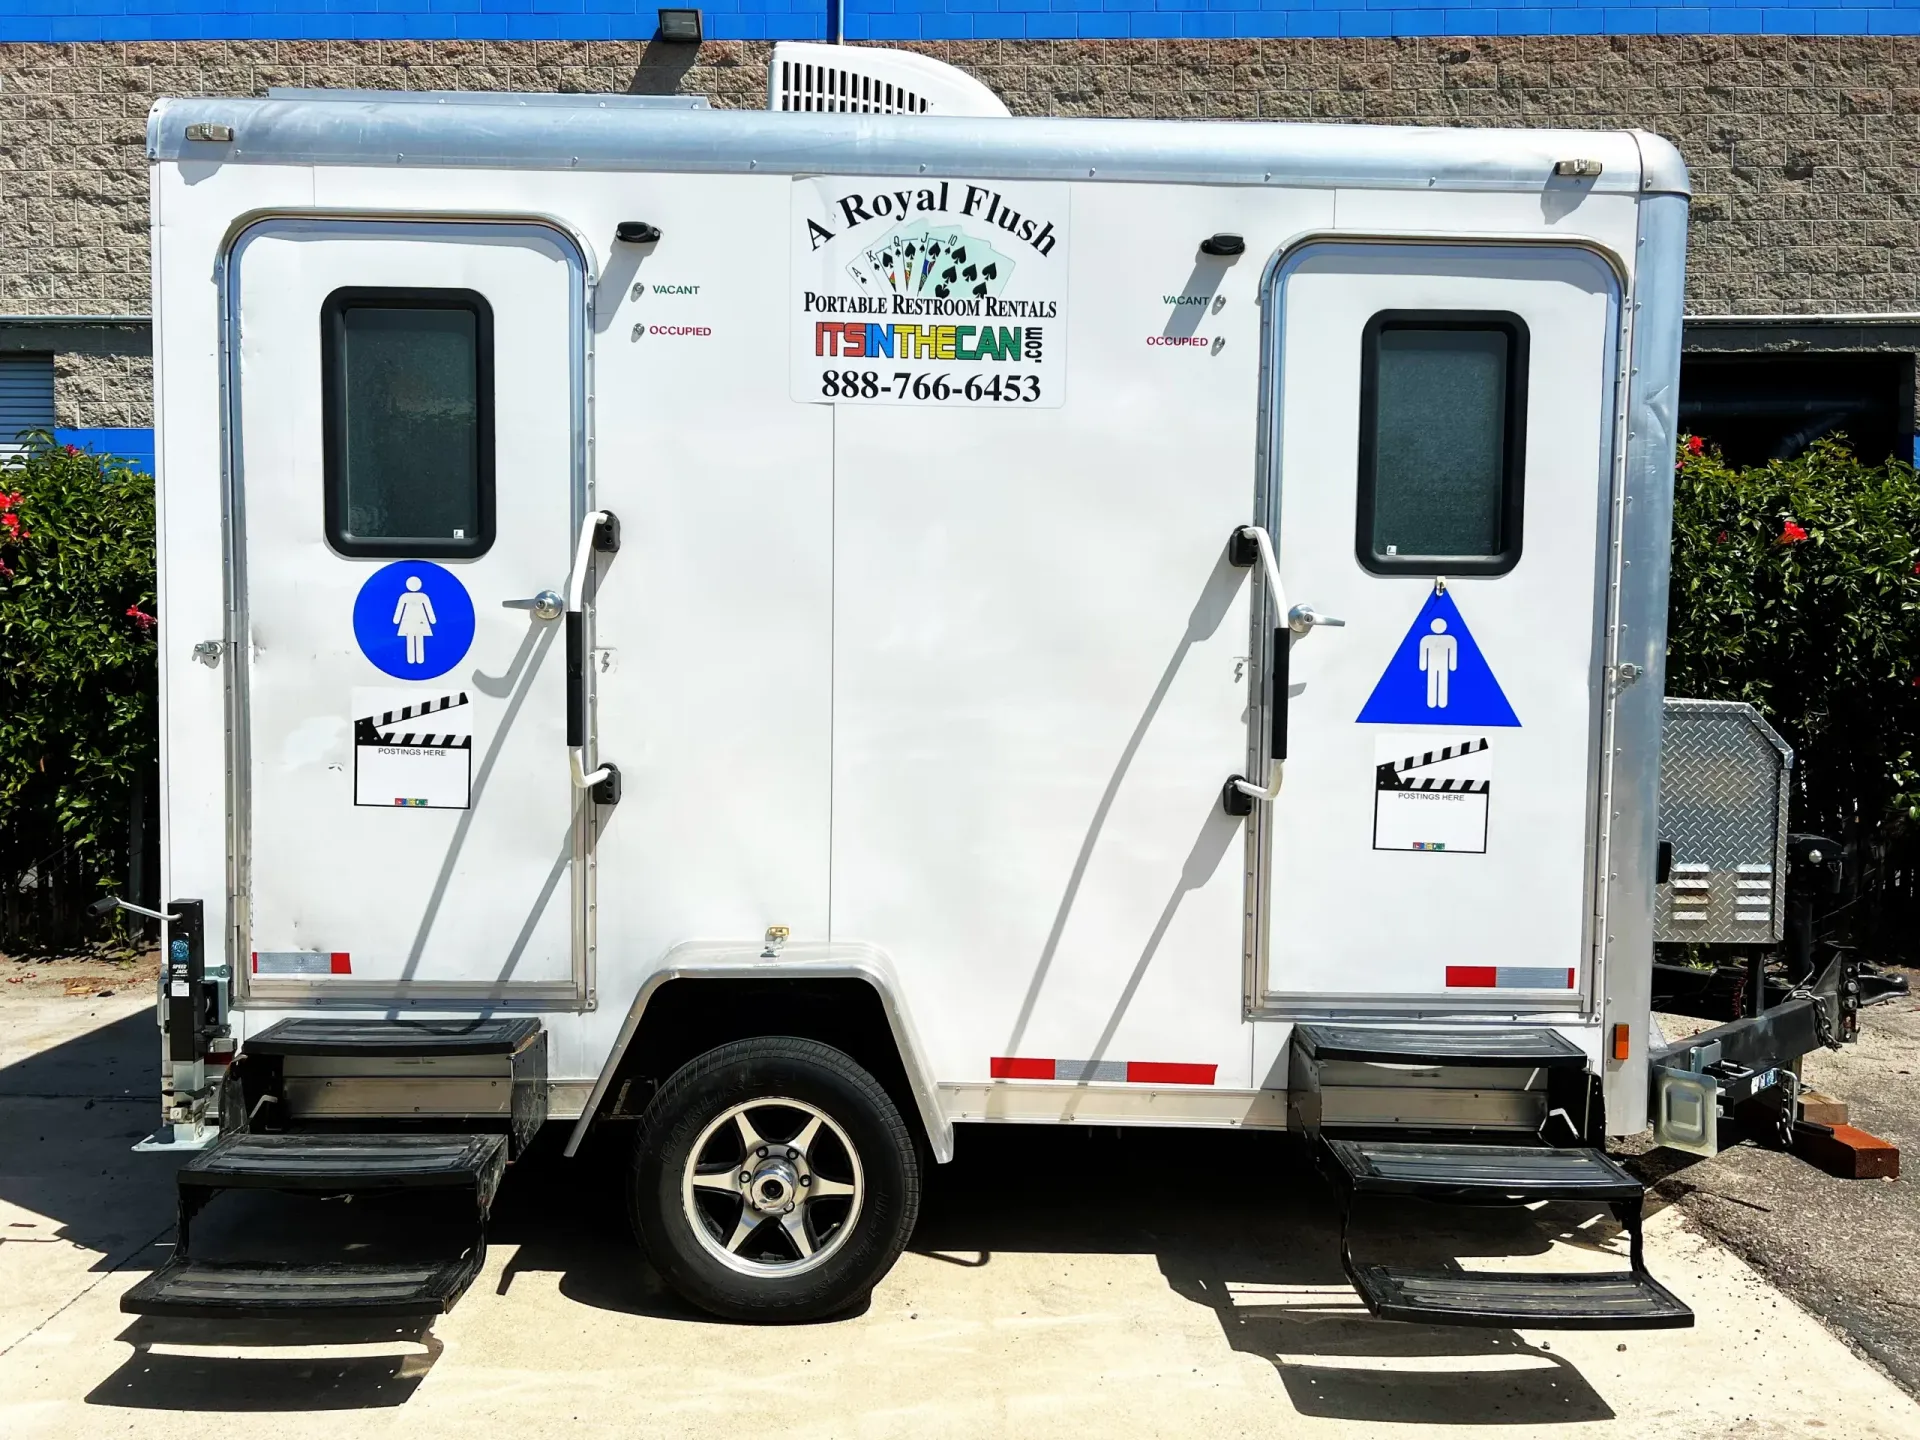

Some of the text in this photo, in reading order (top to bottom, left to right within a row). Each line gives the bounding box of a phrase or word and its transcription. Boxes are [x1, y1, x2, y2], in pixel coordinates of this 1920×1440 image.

[805, 181, 1057, 258] A Royal Flush
[653, 285, 700, 295] VACANT
[803, 291, 1057, 319] PORTABLE RESTROOM RENTALS
[1163, 295, 1210, 305] VACANT
[649, 325, 712, 336] OCCUPIED
[1146, 336, 1208, 347] OCCUPIED
[821, 369, 1042, 403] 888-766-6453
[378, 747, 447, 757] POSTINGS HERE
[1398, 792, 1440, 801] POSTINGS
